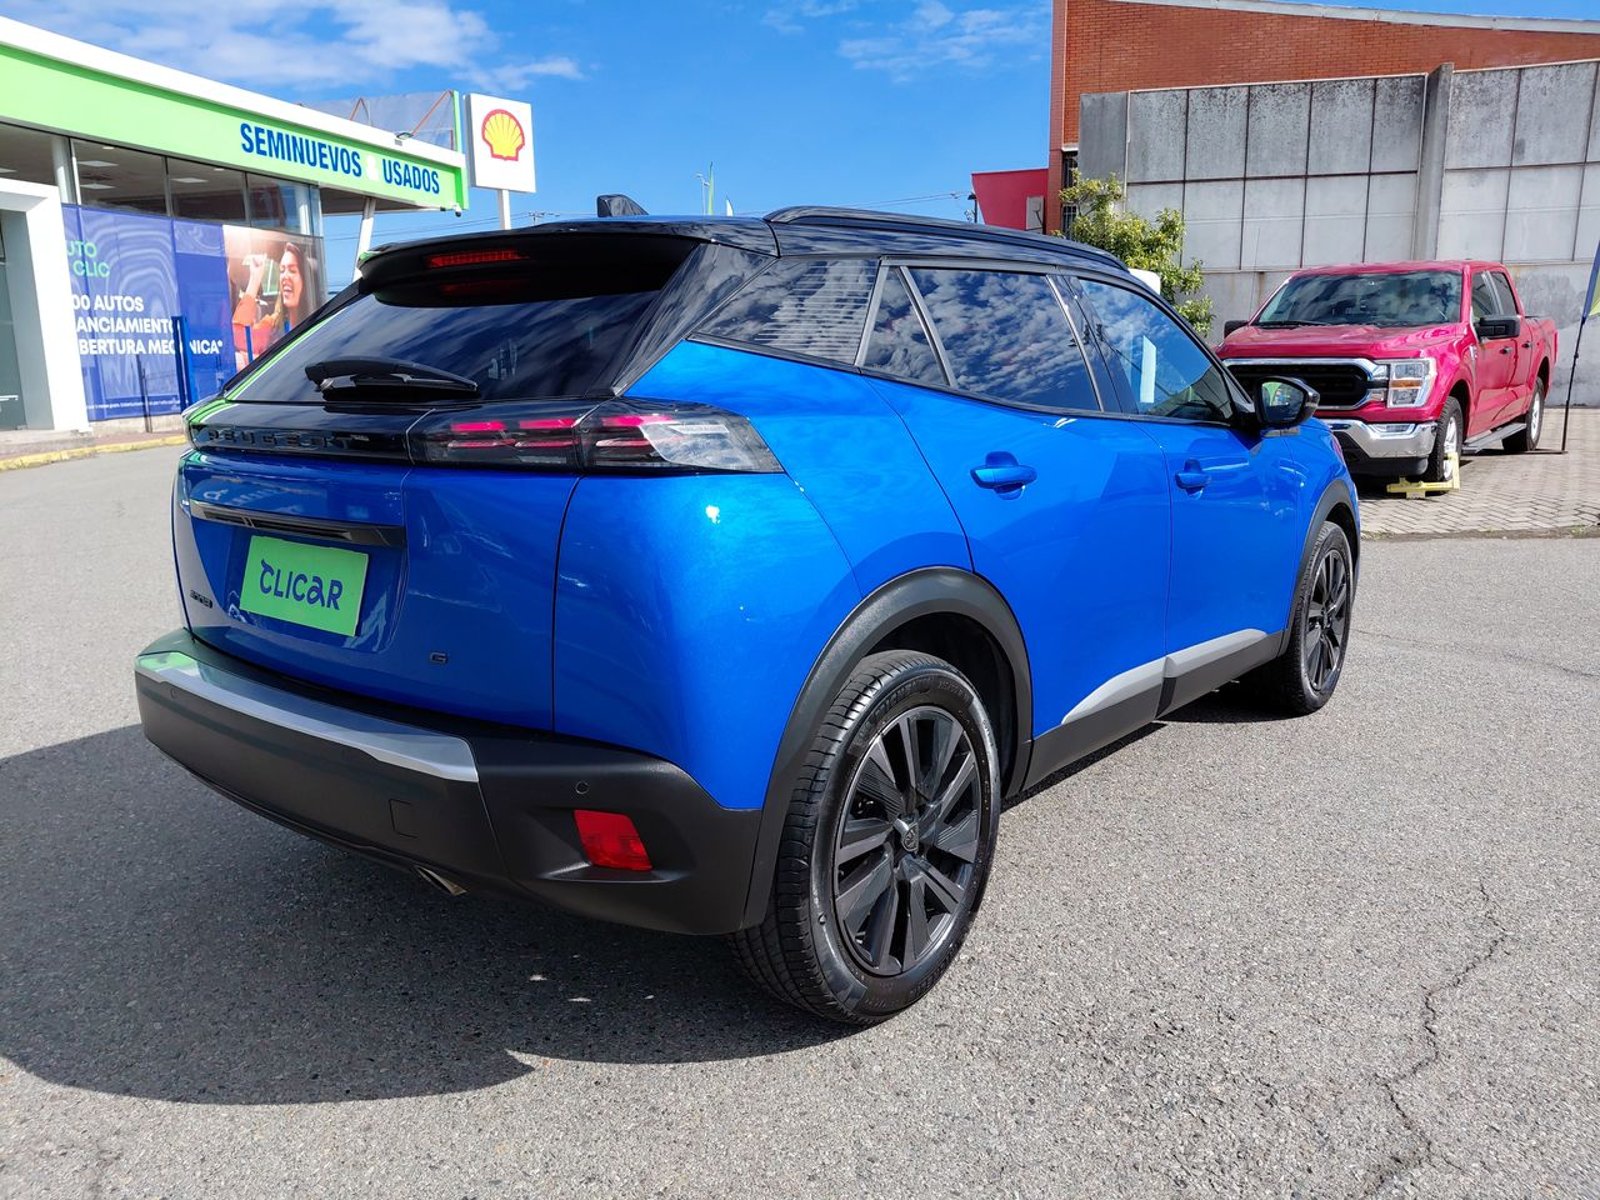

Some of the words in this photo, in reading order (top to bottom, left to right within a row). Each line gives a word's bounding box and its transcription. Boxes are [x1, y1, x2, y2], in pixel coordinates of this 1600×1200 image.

[240, 123, 362, 177] SEMINUEVOS
[382, 158, 440, 194] USADOS
[73, 260, 110, 278] CLIC
[94, 294, 144, 312] AUTOS
[79, 339, 146, 355] BERTURA
